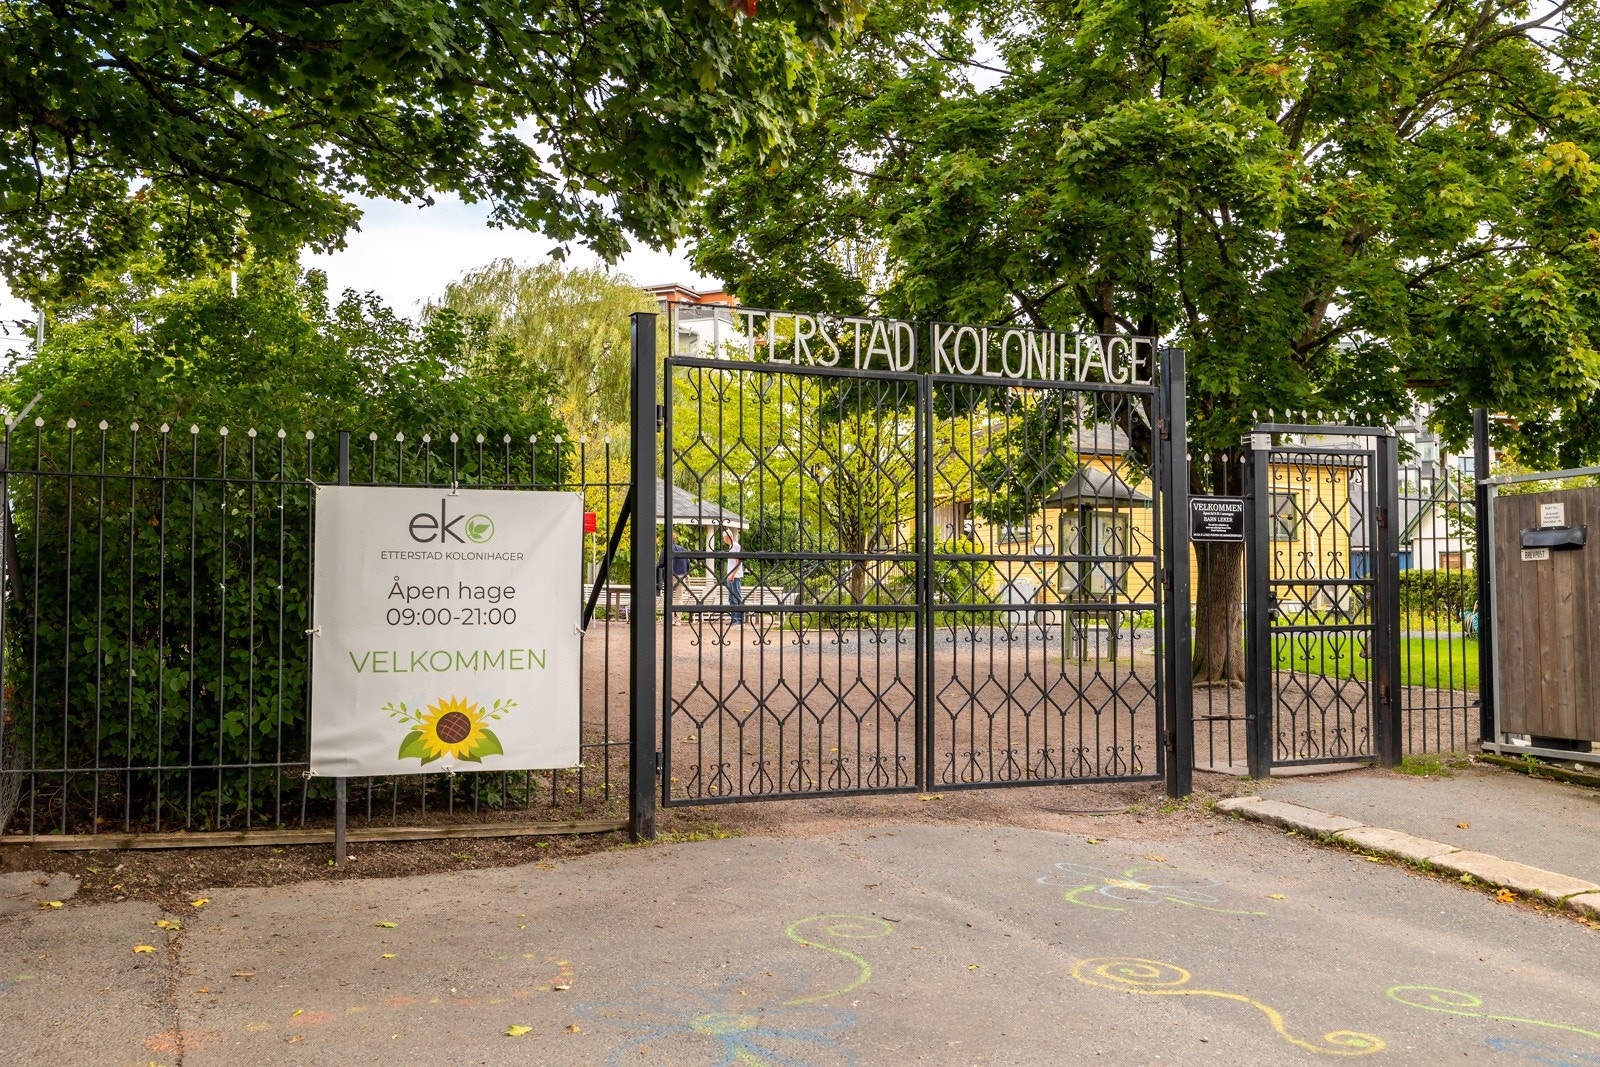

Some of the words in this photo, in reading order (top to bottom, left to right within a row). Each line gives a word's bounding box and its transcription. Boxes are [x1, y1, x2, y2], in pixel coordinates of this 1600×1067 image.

[934, 324, 1152, 385] KOLONIHAGE
[1193, 503, 1242, 512] VELKOMMEN
[409, 498, 495, 544] eko
[381, 550, 443, 560] ETTERSTAD
[445, 551, 524, 561] KOLONIHAGER
[388, 575, 450, 603] Åpen
[459, 582, 515, 603] hage
[386, 608, 517, 626] 09:00-21:00
[349, 649, 546, 673] VELKOMMEN
